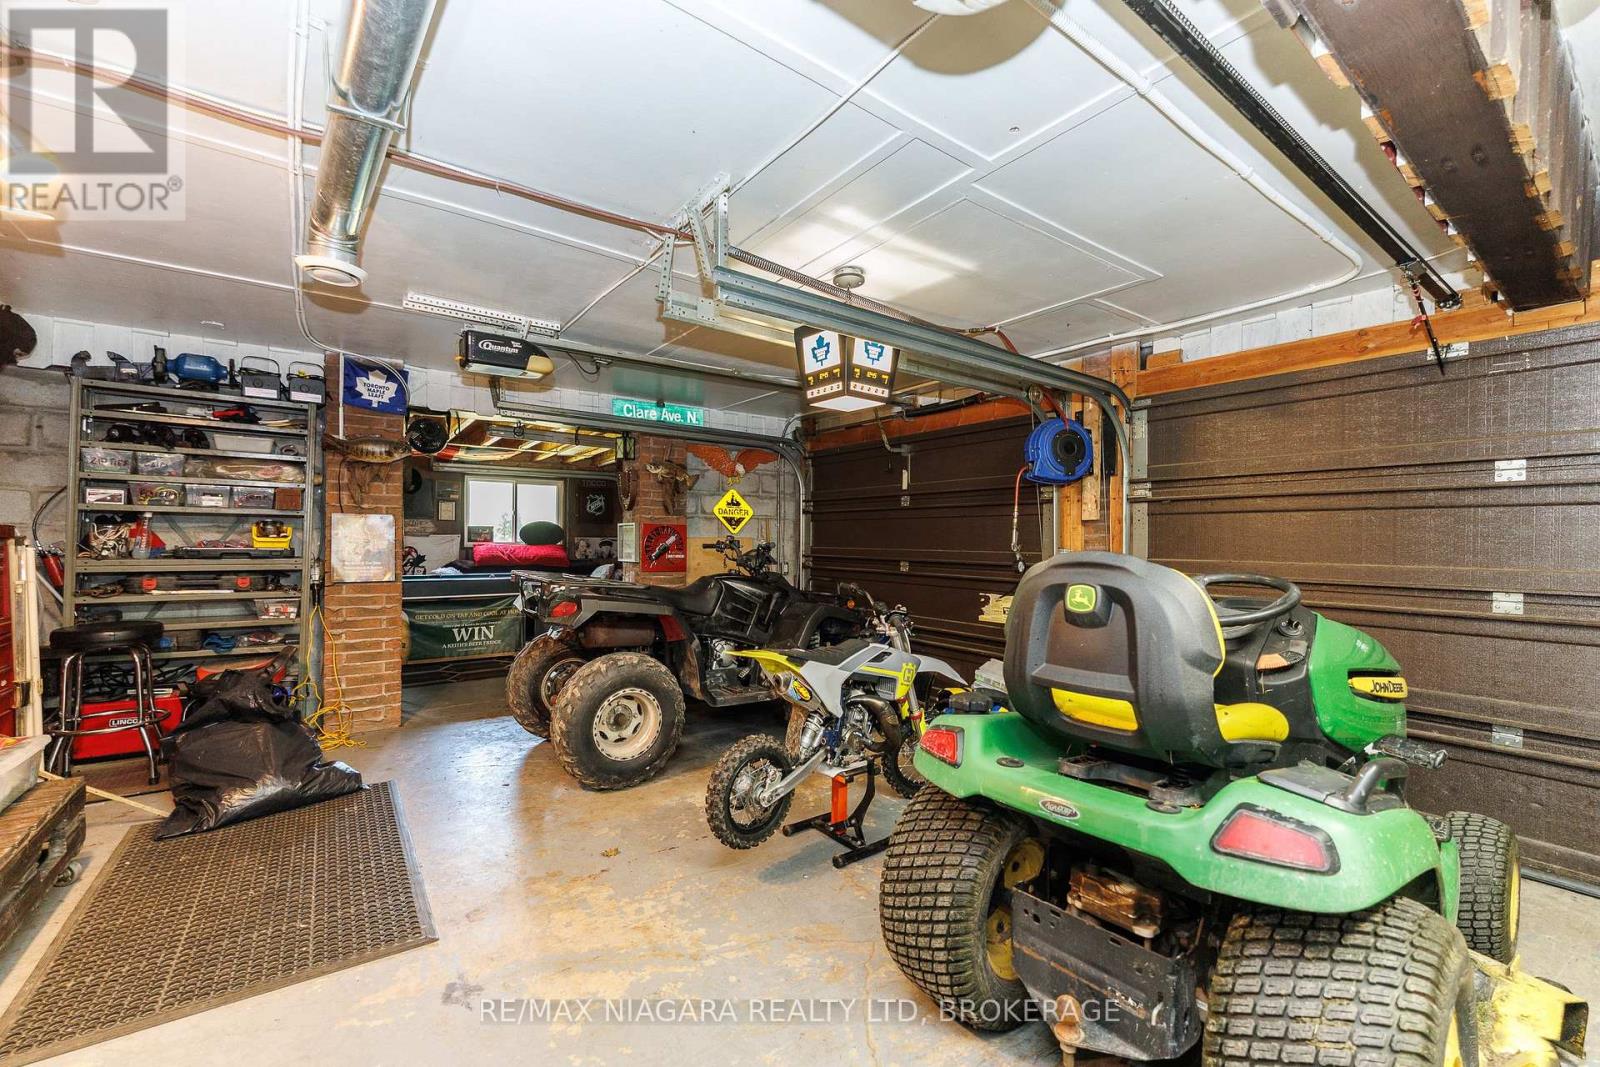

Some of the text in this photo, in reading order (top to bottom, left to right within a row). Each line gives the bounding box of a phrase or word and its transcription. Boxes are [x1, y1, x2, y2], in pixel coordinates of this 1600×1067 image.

[480, 340, 519, 354] Quantum
[363, 382, 390, 391] TORONTO
[623, 403, 658, 421] Clare
[660, 408, 685, 423] Ave.
[718, 507, 749, 516] DANGER
[452, 625, 496, 642] WIN
